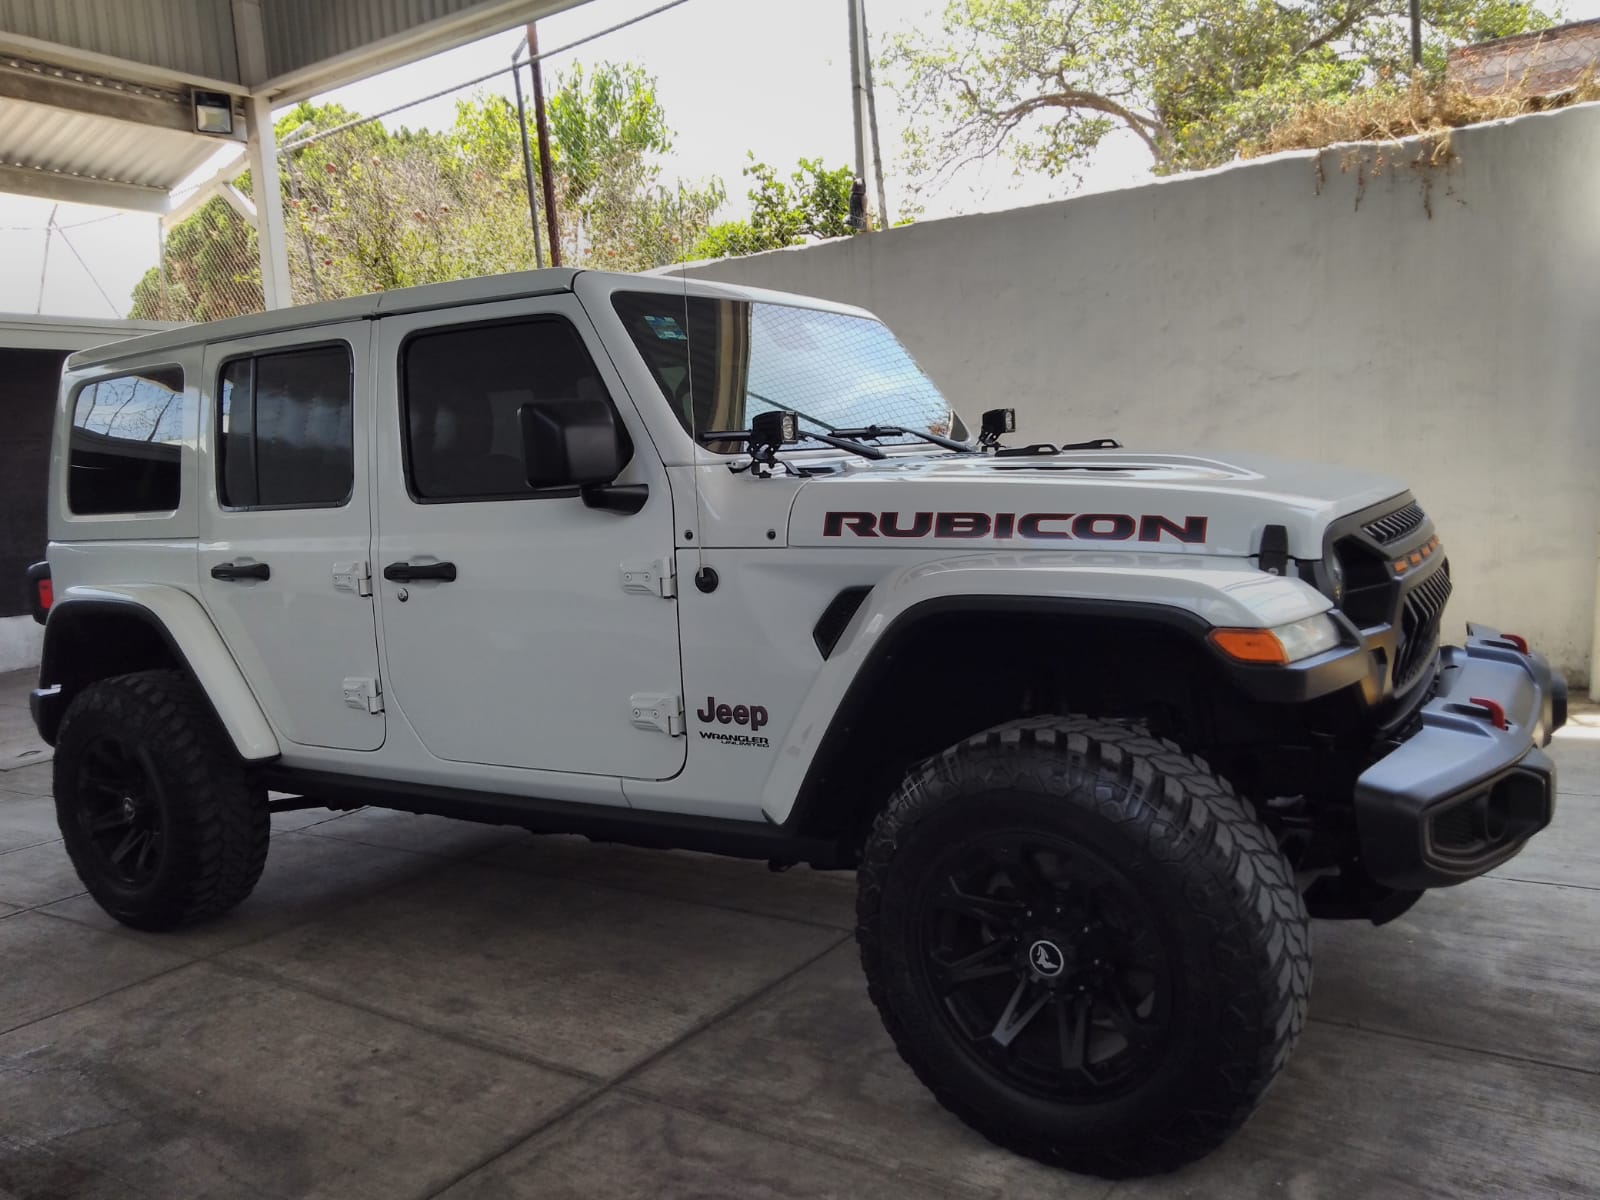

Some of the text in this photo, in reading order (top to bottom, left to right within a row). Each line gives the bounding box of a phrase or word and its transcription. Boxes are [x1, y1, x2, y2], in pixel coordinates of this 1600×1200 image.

[823, 511, 1208, 543] RUBICON
[697, 696, 768, 731] Jeep
[699, 731, 769, 744] WRANGLER
